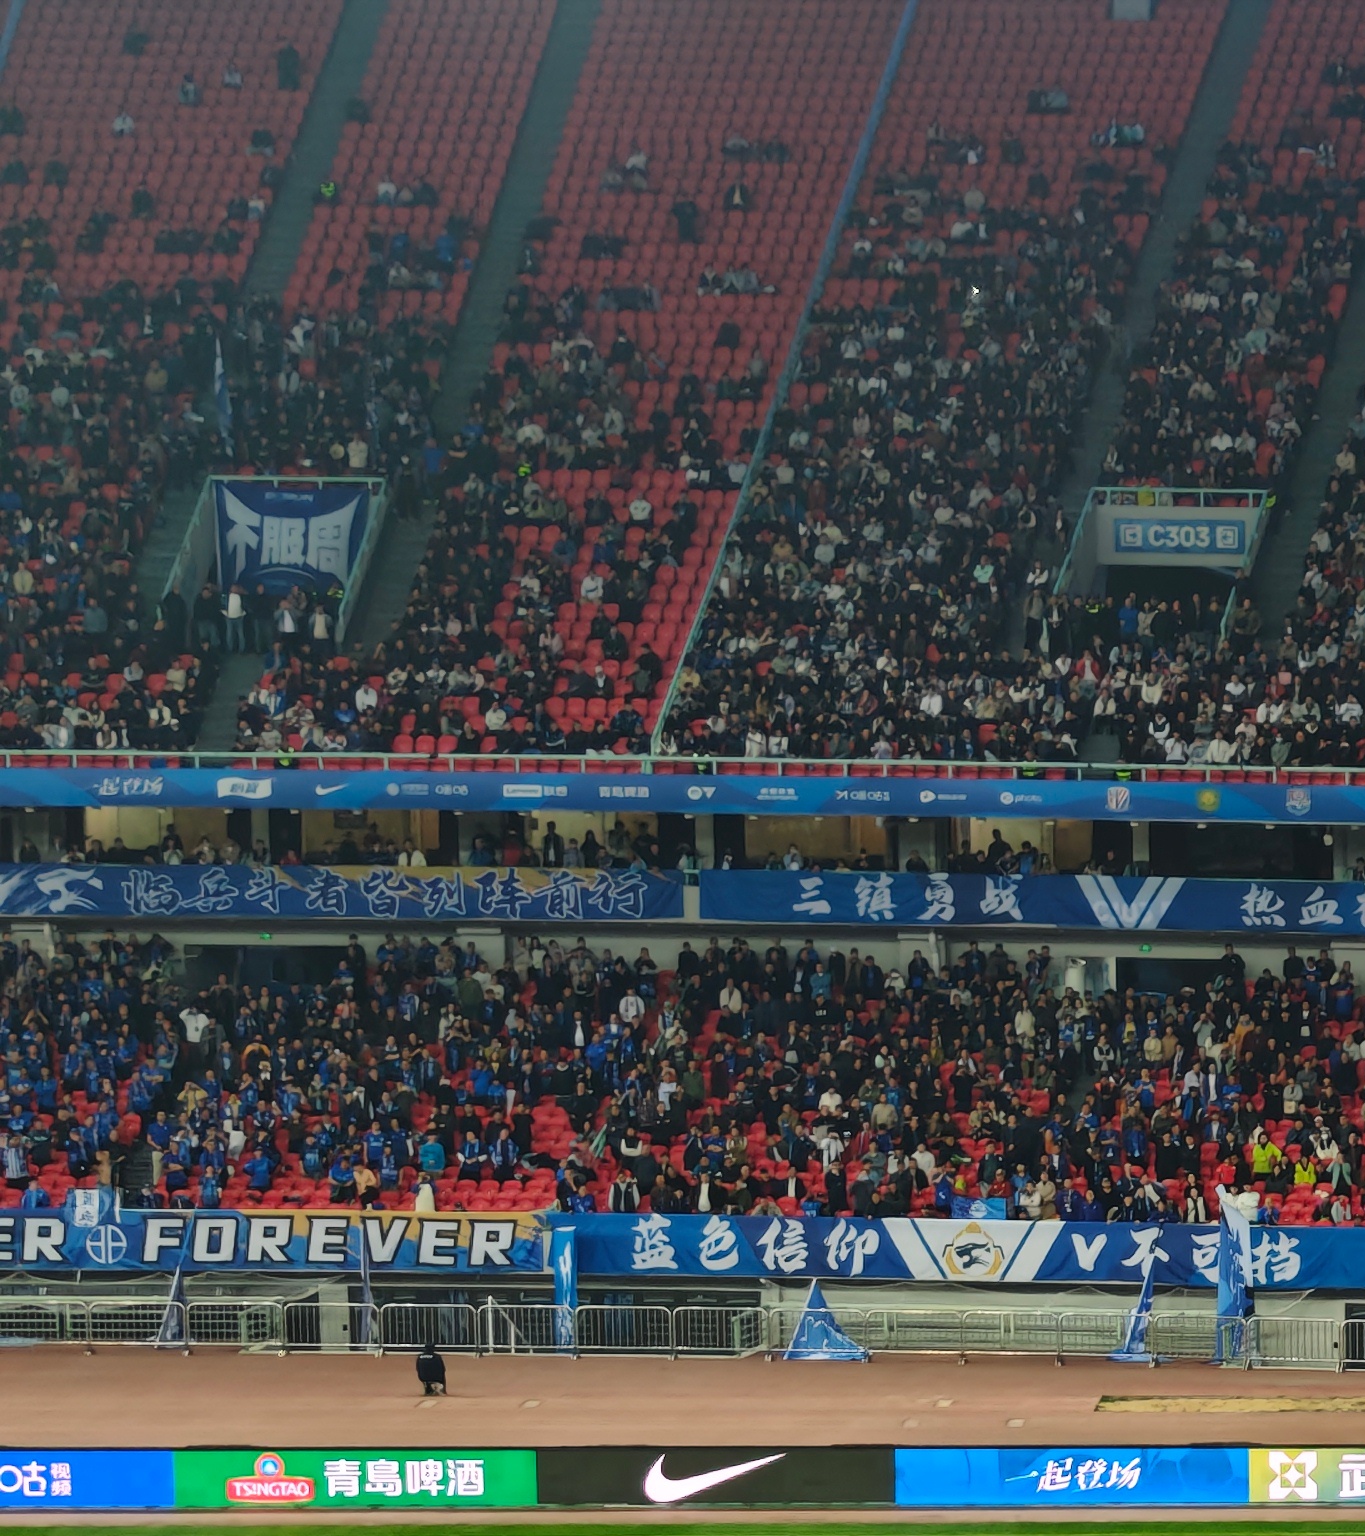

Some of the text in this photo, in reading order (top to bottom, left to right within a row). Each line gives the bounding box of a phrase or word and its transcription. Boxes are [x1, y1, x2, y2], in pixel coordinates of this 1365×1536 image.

[1148, 524, 1211, 549] C303
[792, 873, 1025, 923] 三镇勇战
[142, 1214, 518, 1267] FOREVER
[630, 1213, 880, 1278] 蓝色信仰
[233, 1481, 310, 1498] TSINGTAO
[1004, 1457, 1142, 1493] 一起登场
